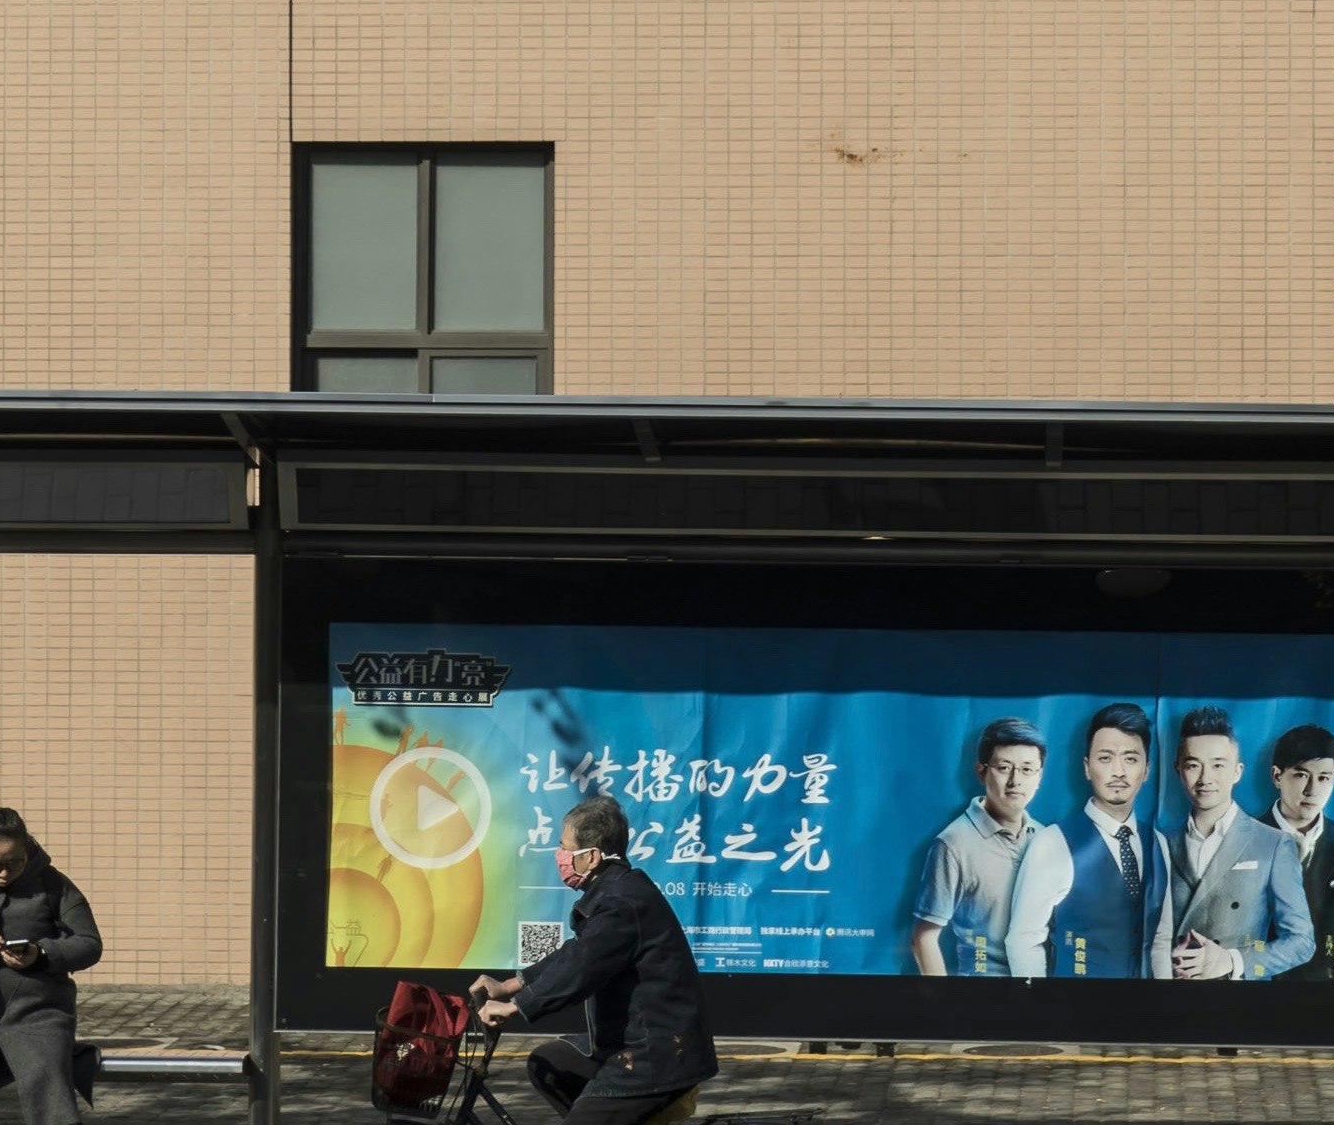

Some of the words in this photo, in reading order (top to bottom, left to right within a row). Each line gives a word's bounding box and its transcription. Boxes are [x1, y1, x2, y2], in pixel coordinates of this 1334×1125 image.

[357, 691, 489, 703] 优秀公益广告走心展
[519, 745, 838, 804] 让传播的力量
[519, 805, 831, 873] 点公益之光
[654, 882, 685, 896] .08
[693, 882, 753, 897] 开始走心
